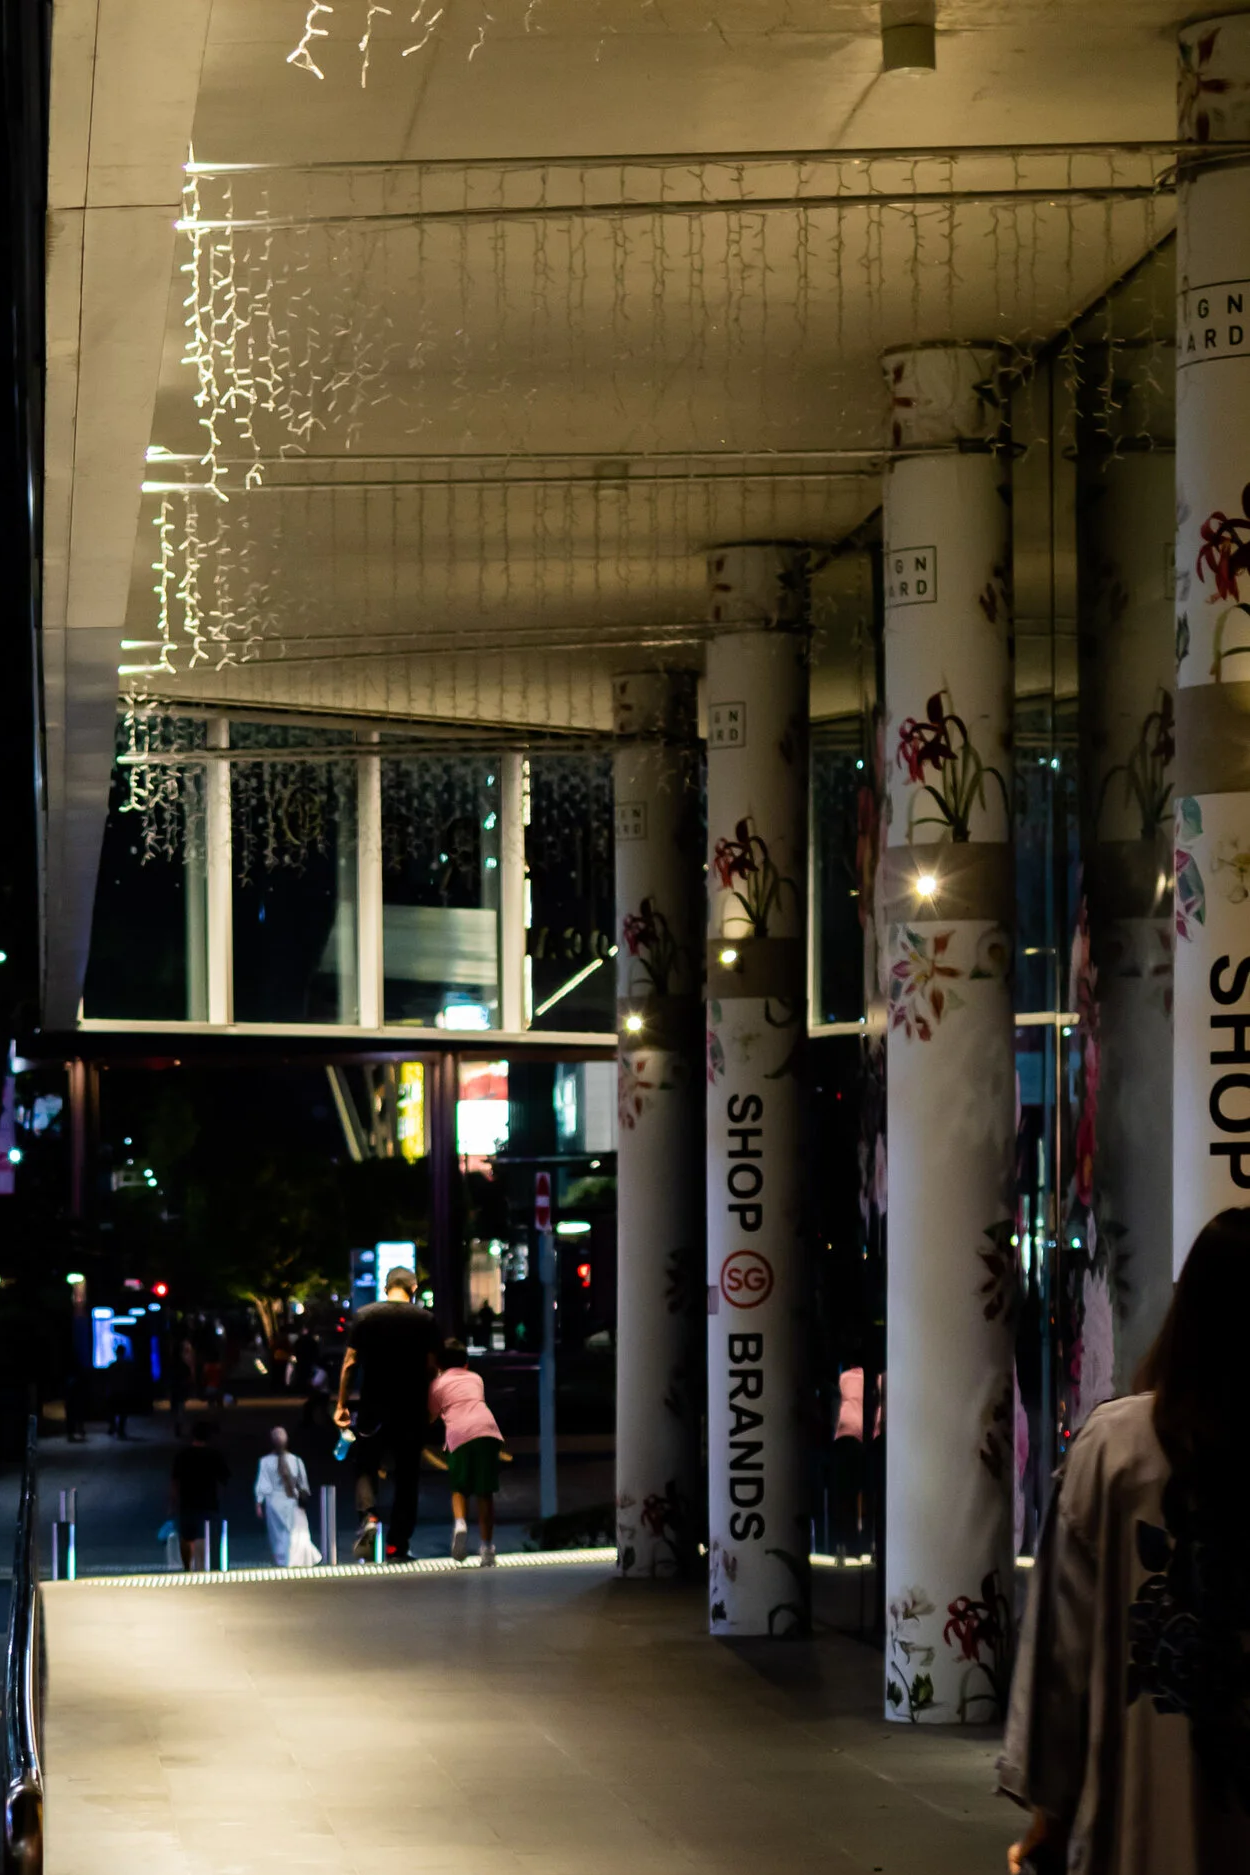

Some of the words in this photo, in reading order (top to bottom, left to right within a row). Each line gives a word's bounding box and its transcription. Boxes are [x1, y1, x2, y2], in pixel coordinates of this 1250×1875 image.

[727, 1094, 764, 1233] SHOP
[1209, 954, 1250, 1189] SHOP
[728, 1333, 766, 1542] BRANDS
